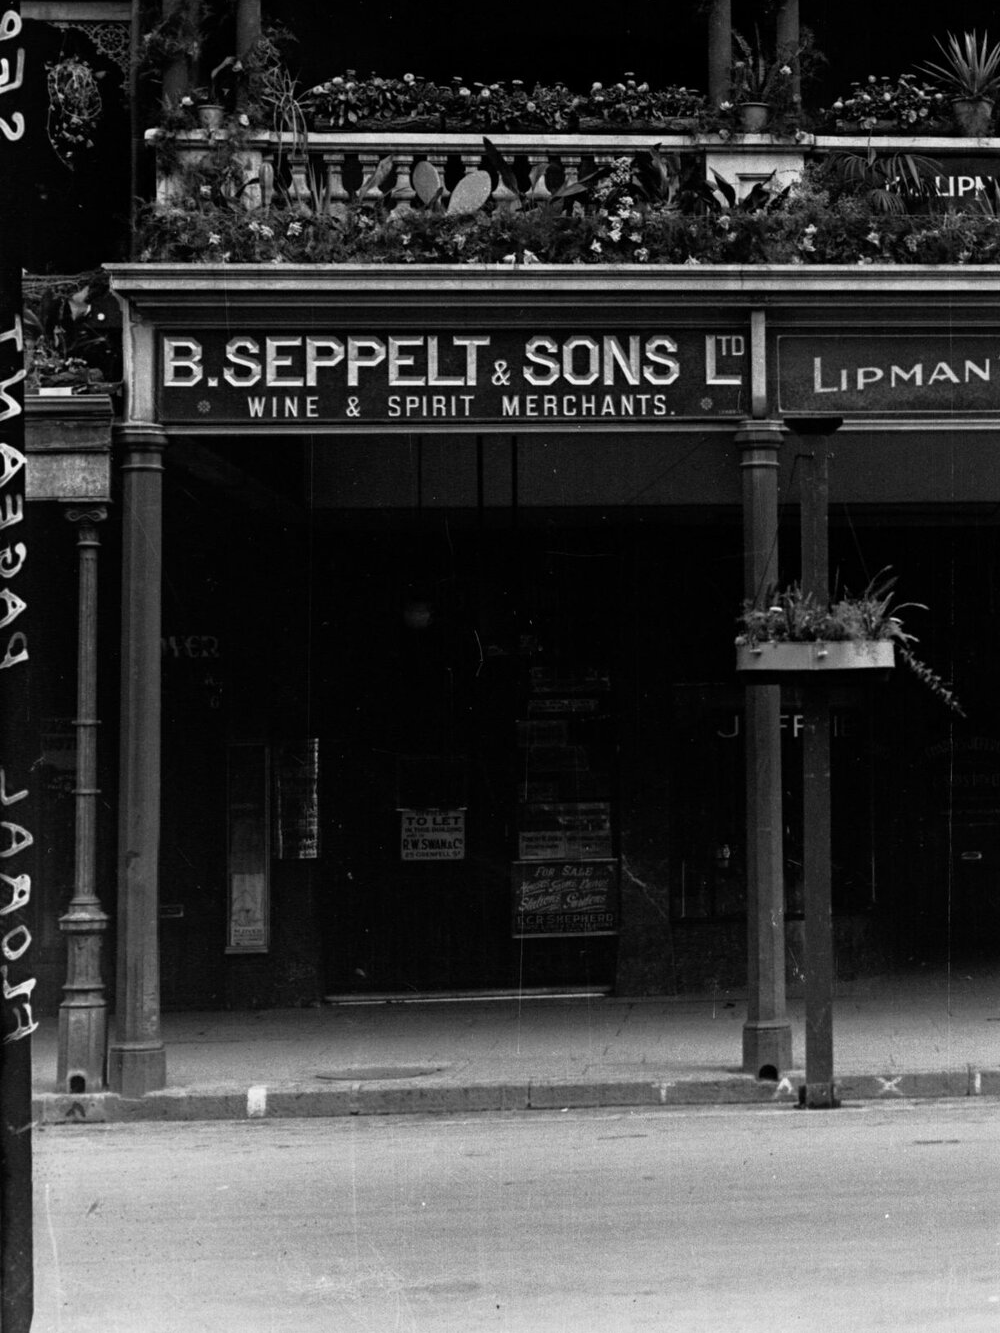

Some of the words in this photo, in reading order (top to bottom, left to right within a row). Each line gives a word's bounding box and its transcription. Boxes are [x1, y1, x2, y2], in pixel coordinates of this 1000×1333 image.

[491, 358, 512, 387] &
[523, 334, 680, 387] SONS
[705, 334, 745, 385] LTD
[248, 395, 320, 418] WINE
[345, 395, 360, 418] &
[388, 395, 475, 418] SPIRIT
[406, 817, 427, 826] TO
[433, 816, 461, 826] LET
[562, 865, 594, 876] SALE
